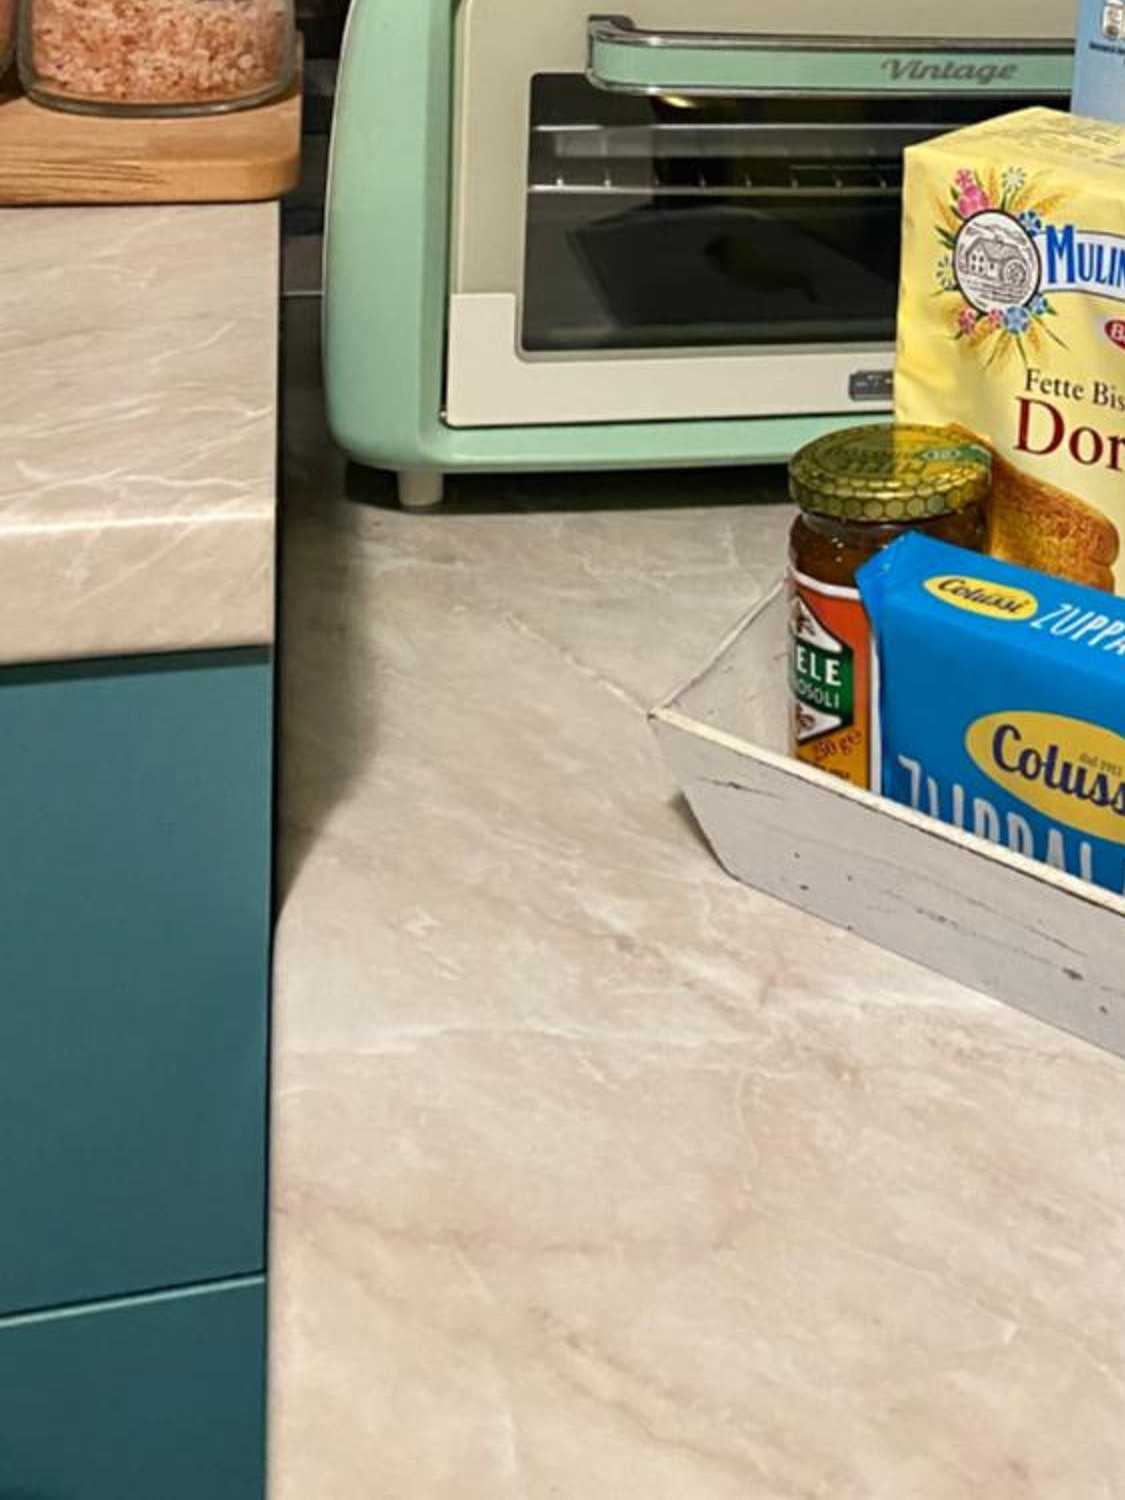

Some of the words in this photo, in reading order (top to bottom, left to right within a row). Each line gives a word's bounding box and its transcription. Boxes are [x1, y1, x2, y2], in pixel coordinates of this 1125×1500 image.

[881, 58, 1019, 85] Vintage
[1025, 368, 1084, 401] Fette
[938, 577, 1025, 614] Colussi
